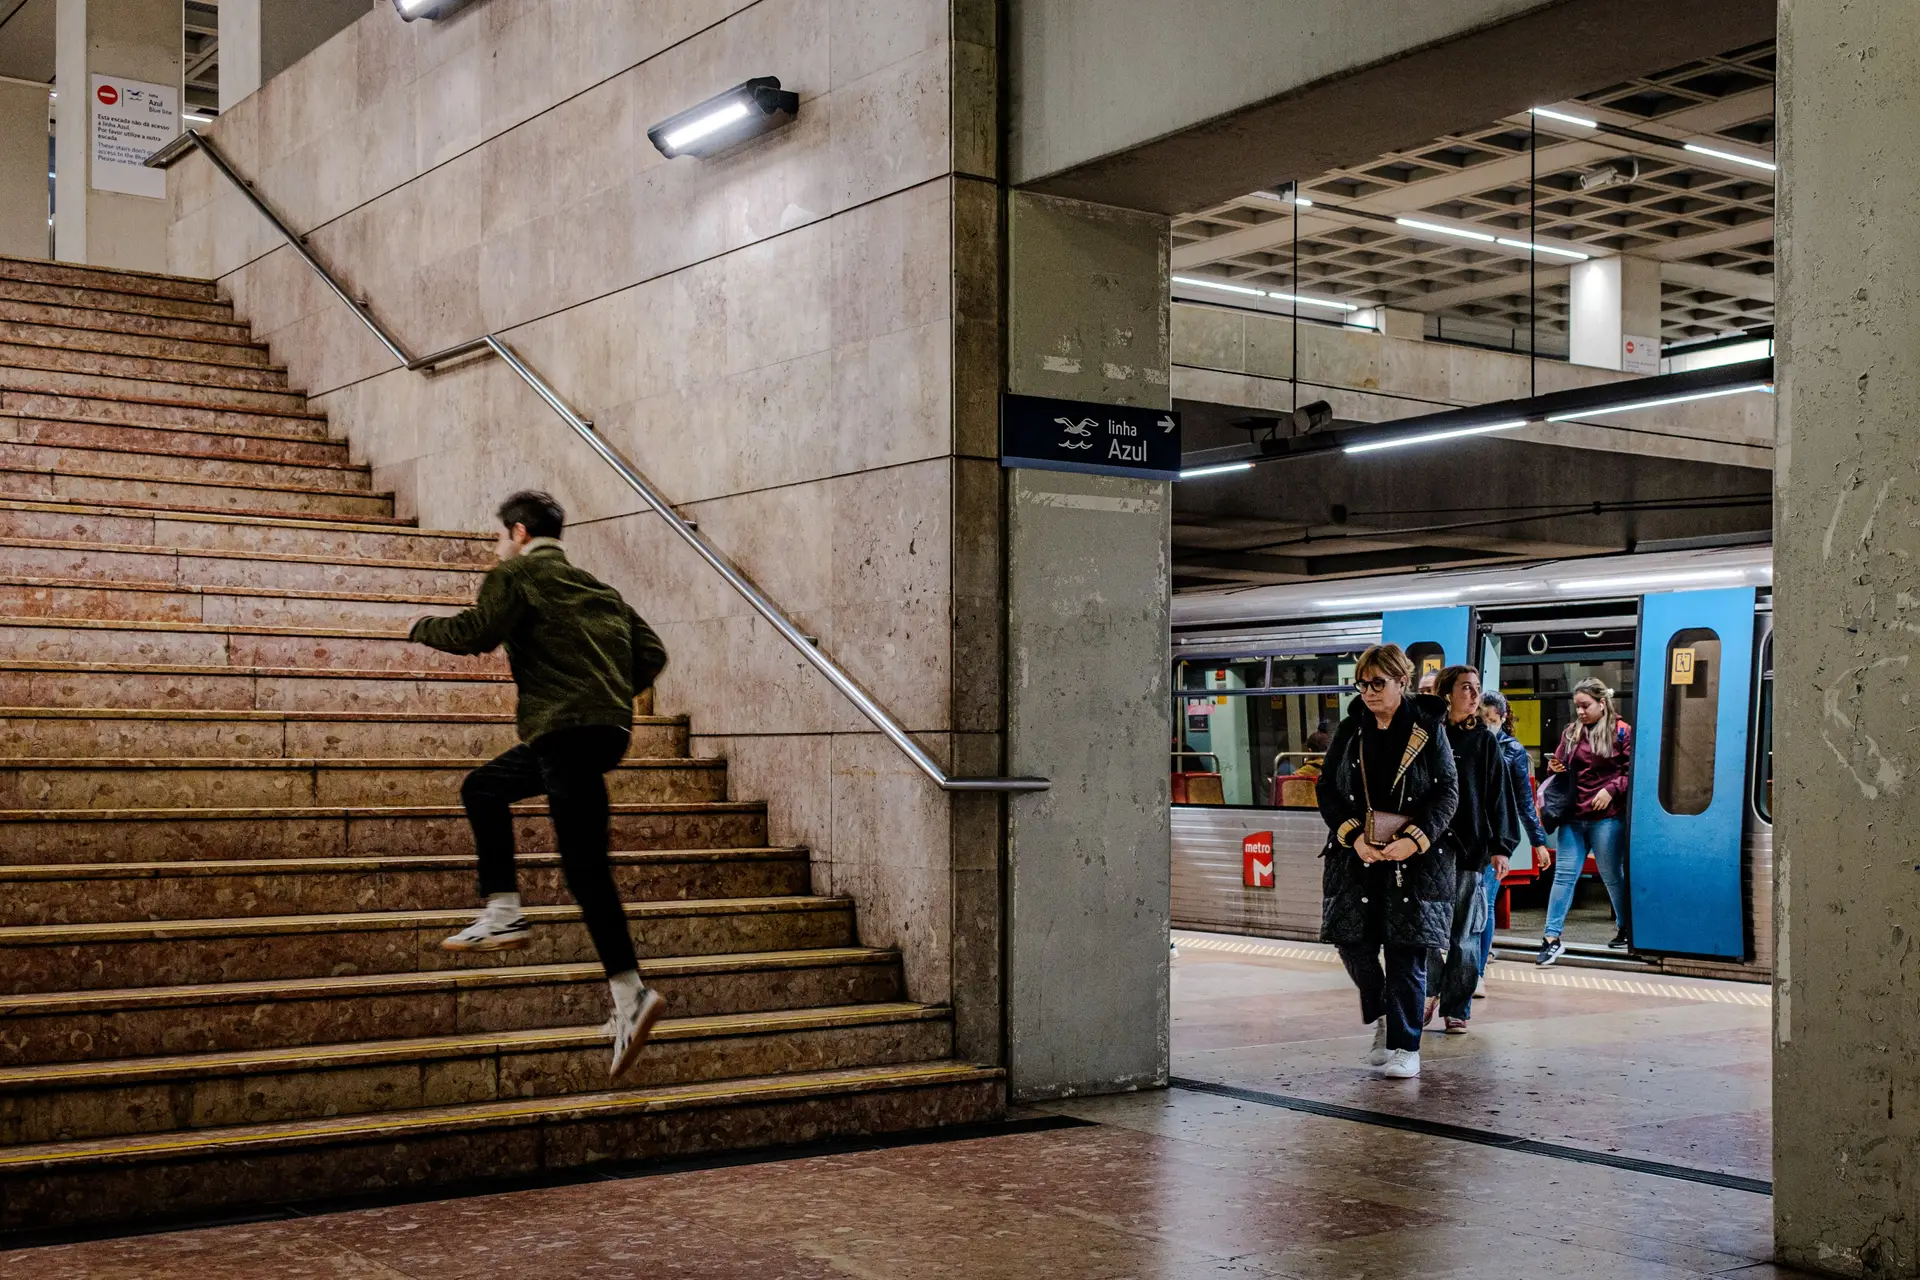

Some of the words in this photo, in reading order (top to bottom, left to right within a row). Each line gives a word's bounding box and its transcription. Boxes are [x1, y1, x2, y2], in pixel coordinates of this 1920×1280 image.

[124, 130, 141, 138] utilize
[116, 144, 130, 152] stairs
[1108, 419, 1137, 437] linha
[1108, 438, 1147, 462] Azul
[1245, 842, 1270, 854] metro
